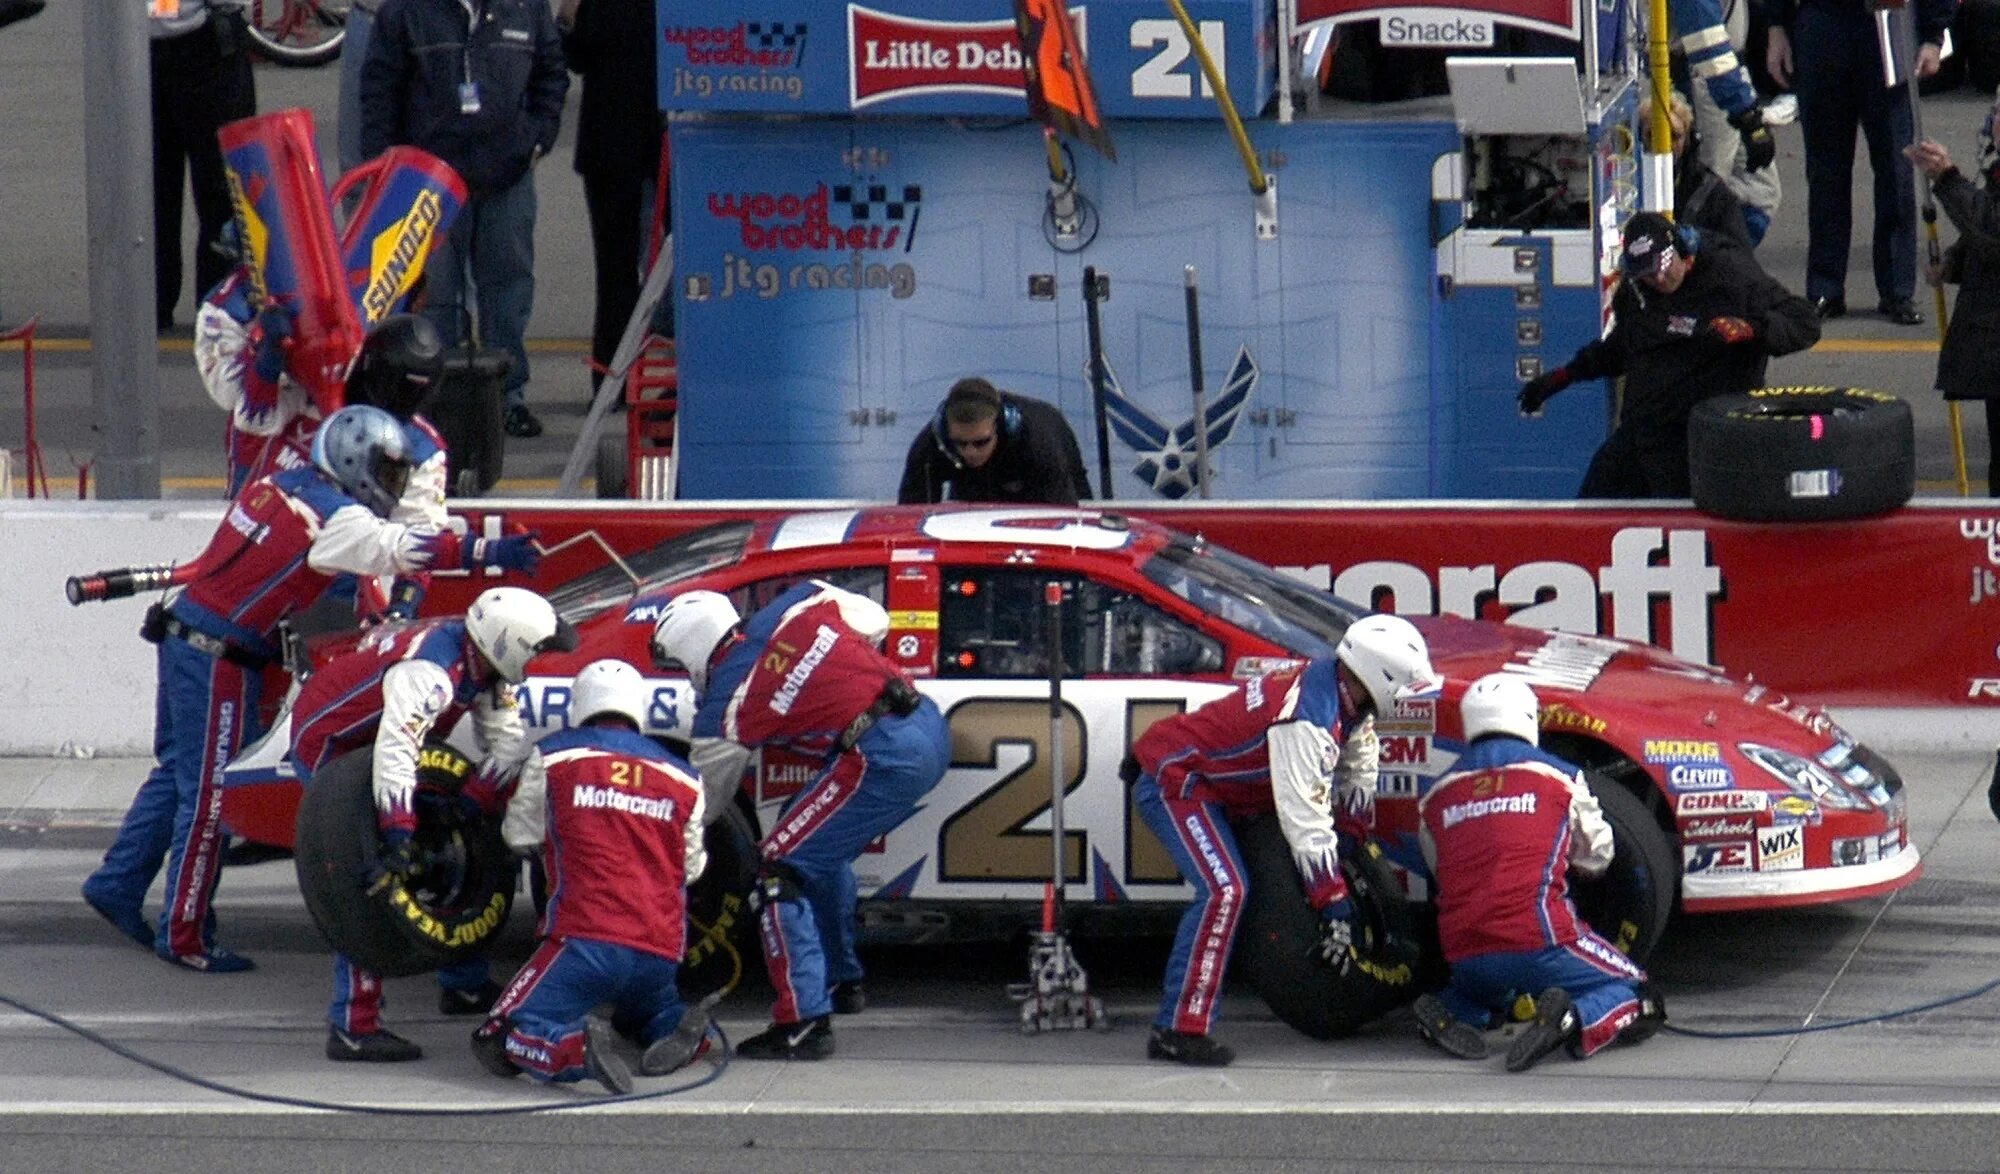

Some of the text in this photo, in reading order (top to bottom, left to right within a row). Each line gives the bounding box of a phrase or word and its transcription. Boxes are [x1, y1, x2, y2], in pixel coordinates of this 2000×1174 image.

[664, 20, 745, 48] wood
[1387, 17, 1486, 42] Snacks
[688, 46, 795, 67] brothers
[865, 40, 1032, 71] Little Deb
[1130, 19, 1224, 97] 21
[673, 68, 803, 100] jtg racing
[707, 182, 829, 225] wood
[741, 216, 901, 251] brothers
[363, 190, 441, 321] SUNOCO
[721, 250, 916, 300] jtg racing
[764, 640, 797, 676] 21
[769, 624, 841, 716] Motorcraft
[649, 687, 680, 730] &
[211, 700, 234, 785] GENUINE
[1379, 737, 1427, 764] 3M
[1645, 740, 1719, 757] MOOG
[418, 750, 469, 777] AGLE
[611, 761, 644, 788] 21
[767, 763, 817, 784] Little
[1671, 765, 1728, 785] CLEVITE
[938, 695, 1189, 886] 21
[1473, 777, 1505, 796] 21
[1796, 762, 1834, 798] 21
[573, 785, 674, 821] Motorcraft
[787, 781, 841, 834] SERVICE
[1442, 793, 1537, 829] Motorcraft
[1682, 794, 1743, 810] COMP
[1683, 818, 1755, 838] Edelbrock
[1760, 828, 1799, 856] WIX
[1185, 814, 1231, 887] GENUINE
[1686, 844, 1746, 873] JE
